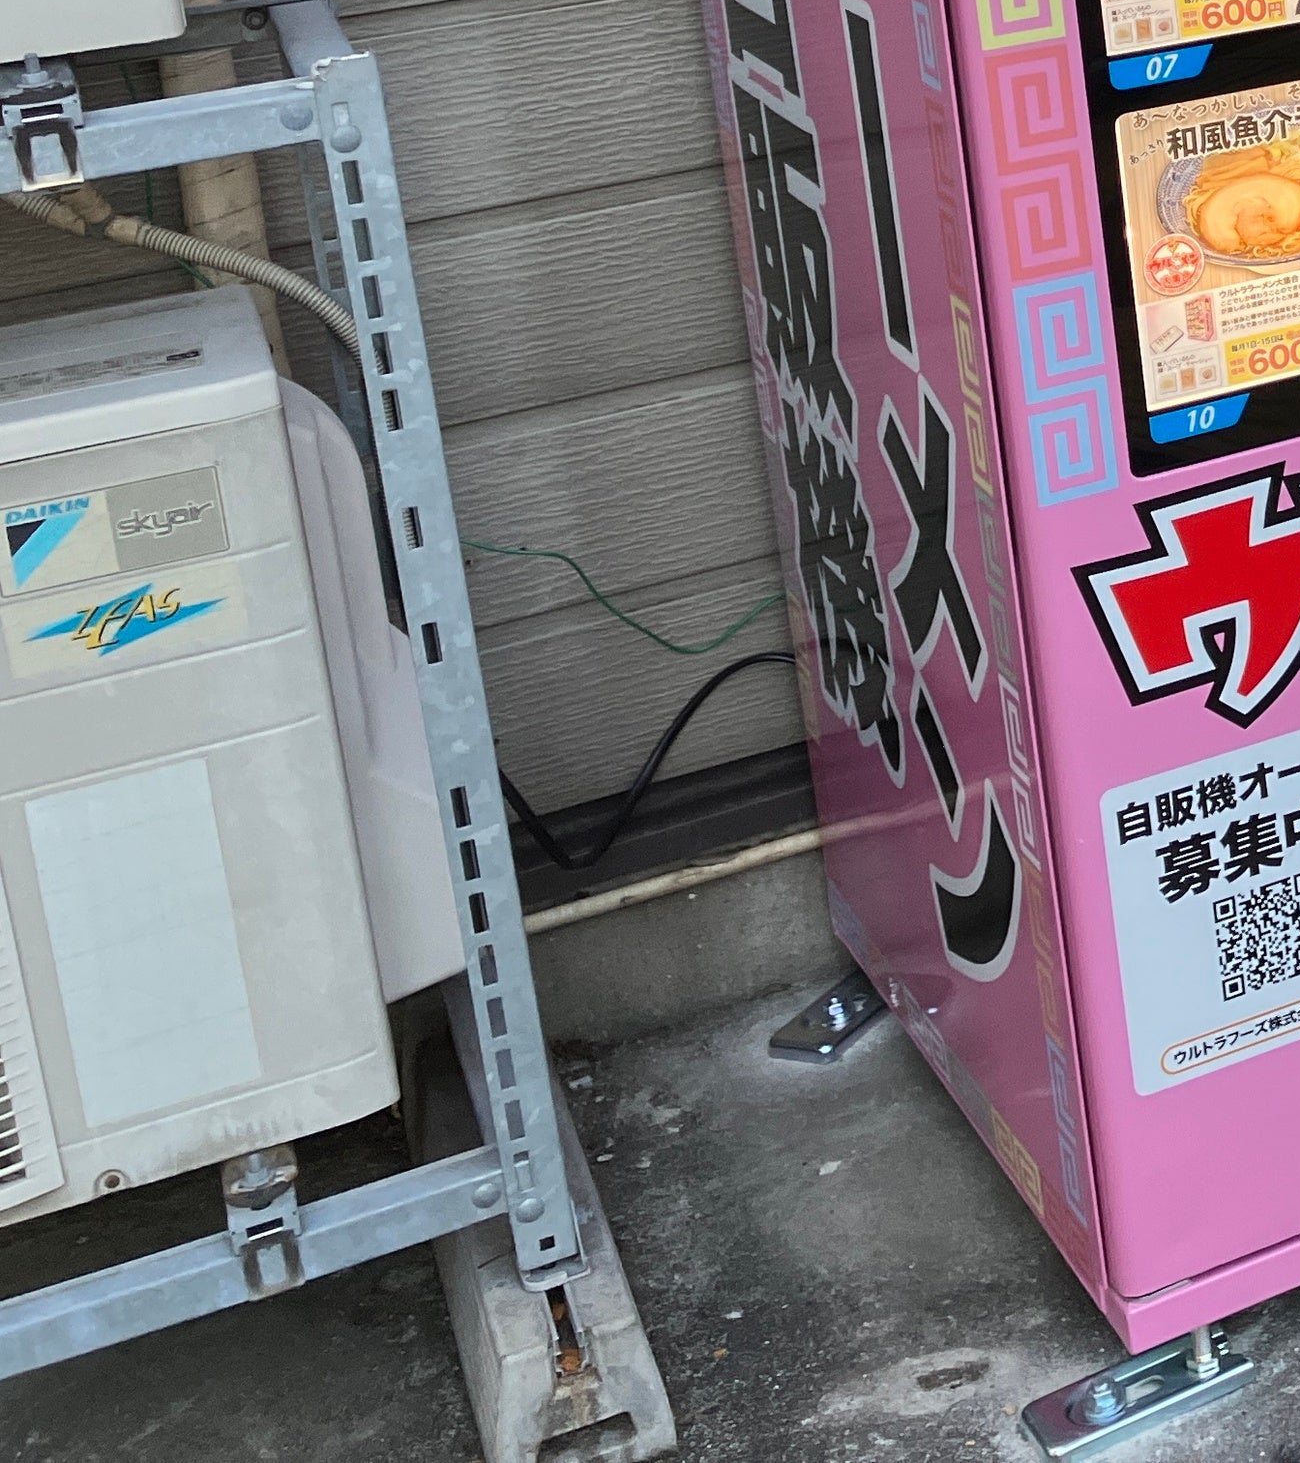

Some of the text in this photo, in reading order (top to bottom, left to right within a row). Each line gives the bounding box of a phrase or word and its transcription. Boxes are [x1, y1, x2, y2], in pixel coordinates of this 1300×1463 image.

[1146, 55, 1178, 80] 07
[1186, 406, 1215, 432] 10
[6, 497, 91, 524] DAIKIN
[116, 500, 214, 538] skyair
